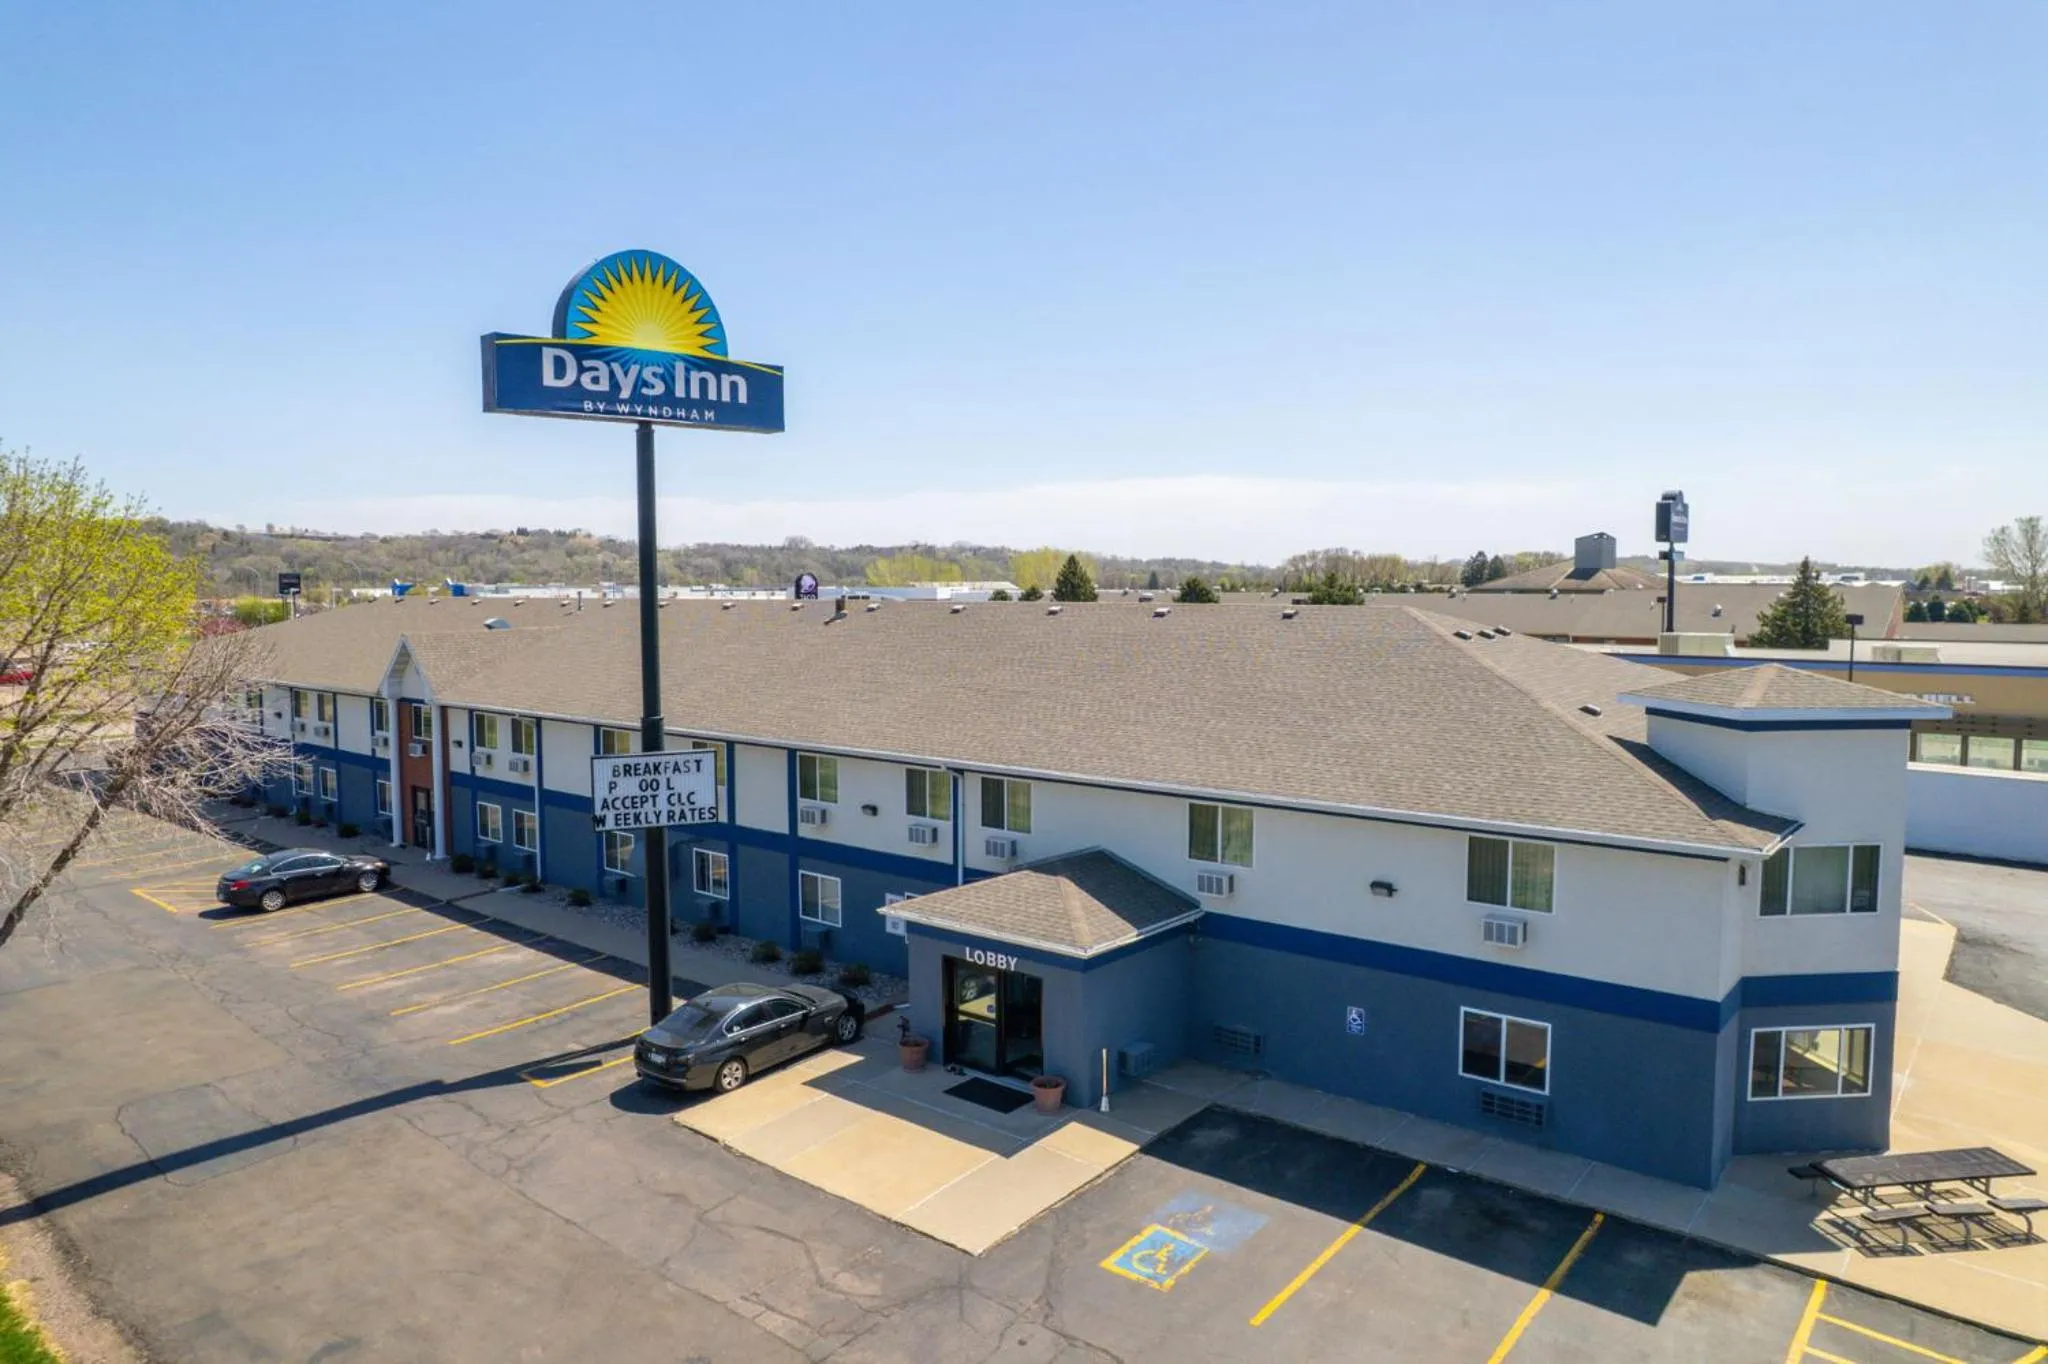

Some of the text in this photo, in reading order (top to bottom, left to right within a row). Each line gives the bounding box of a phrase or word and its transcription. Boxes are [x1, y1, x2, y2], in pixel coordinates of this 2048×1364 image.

[541, 346, 748, 405] Days Inn
[583, 401, 716, 422] BY WYNDHAM
[612, 759, 703, 778] BREAKFAST
[601, 791, 696, 811] ACCEPT CLC
[667, 806, 717, 823] RATES
[965, 947, 1018, 972] LOBBY
